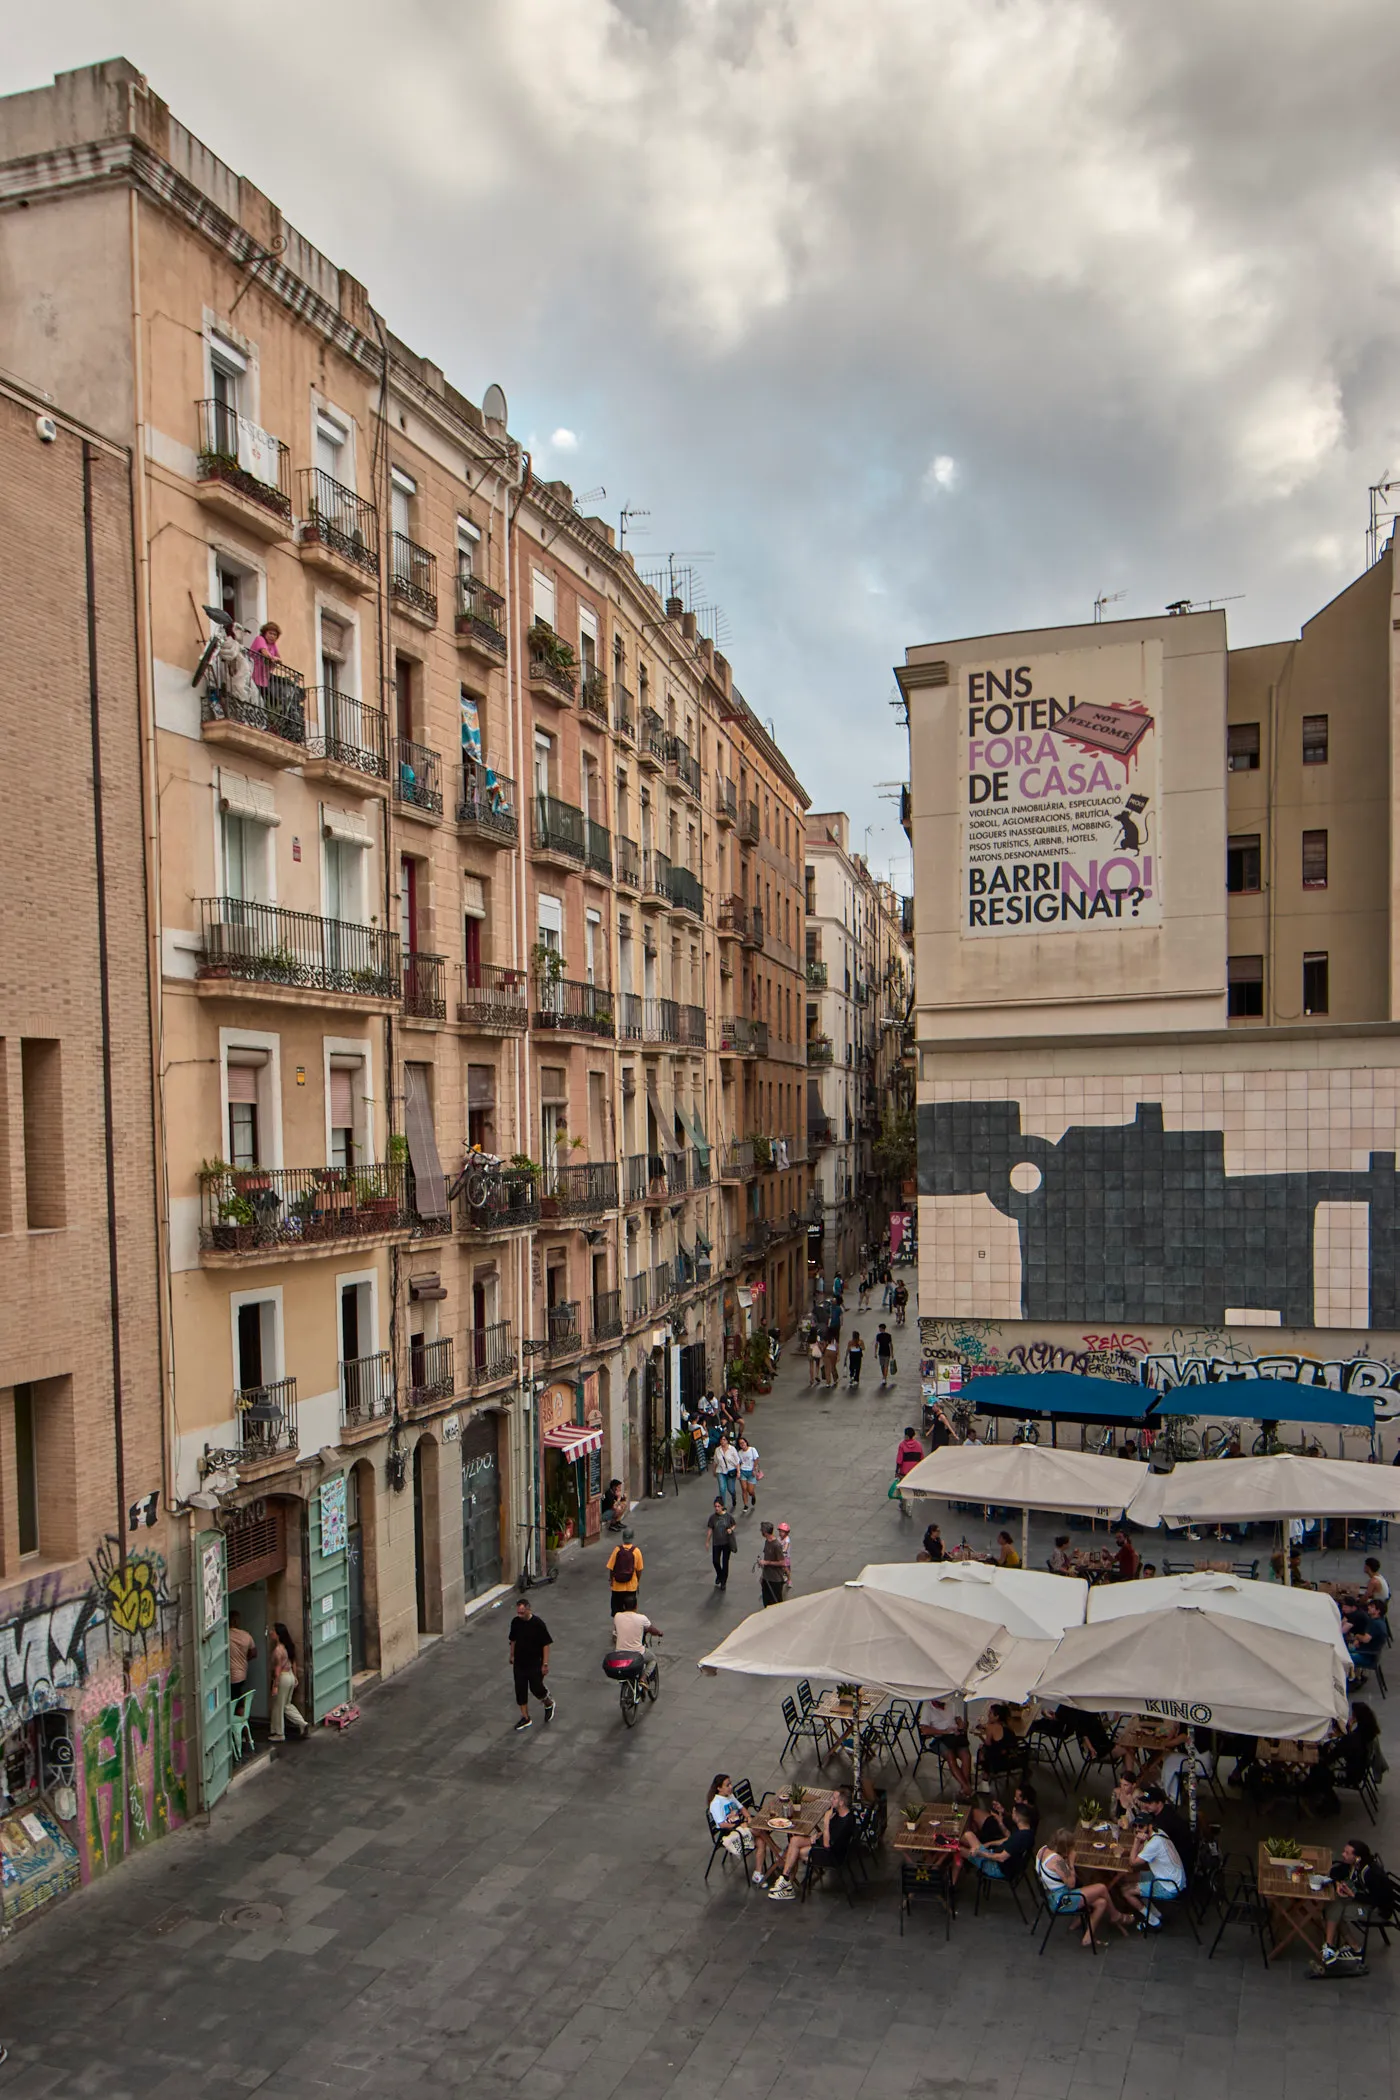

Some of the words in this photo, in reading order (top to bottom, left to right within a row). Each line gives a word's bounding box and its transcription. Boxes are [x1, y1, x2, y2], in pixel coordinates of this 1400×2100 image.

[969, 666, 1032, 703] ENS
[969, 696, 1075, 737] FOTEN
[1068, 717, 1133, 740] WELCOME
[1093, 713, 1120, 724] NOT
[969, 733, 1060, 771] FORA
[969, 771, 1008, 804] DE
[1019, 760, 1122, 799] CASA.
[969, 831, 1007, 841] LLOGUERS
[969, 843, 992, 852] PISOS
[1066, 834, 1098, 844] HOTELS,
[969, 887, 1145, 927] RESIGNAT?
[1145, 1700, 1212, 1724] KINO
